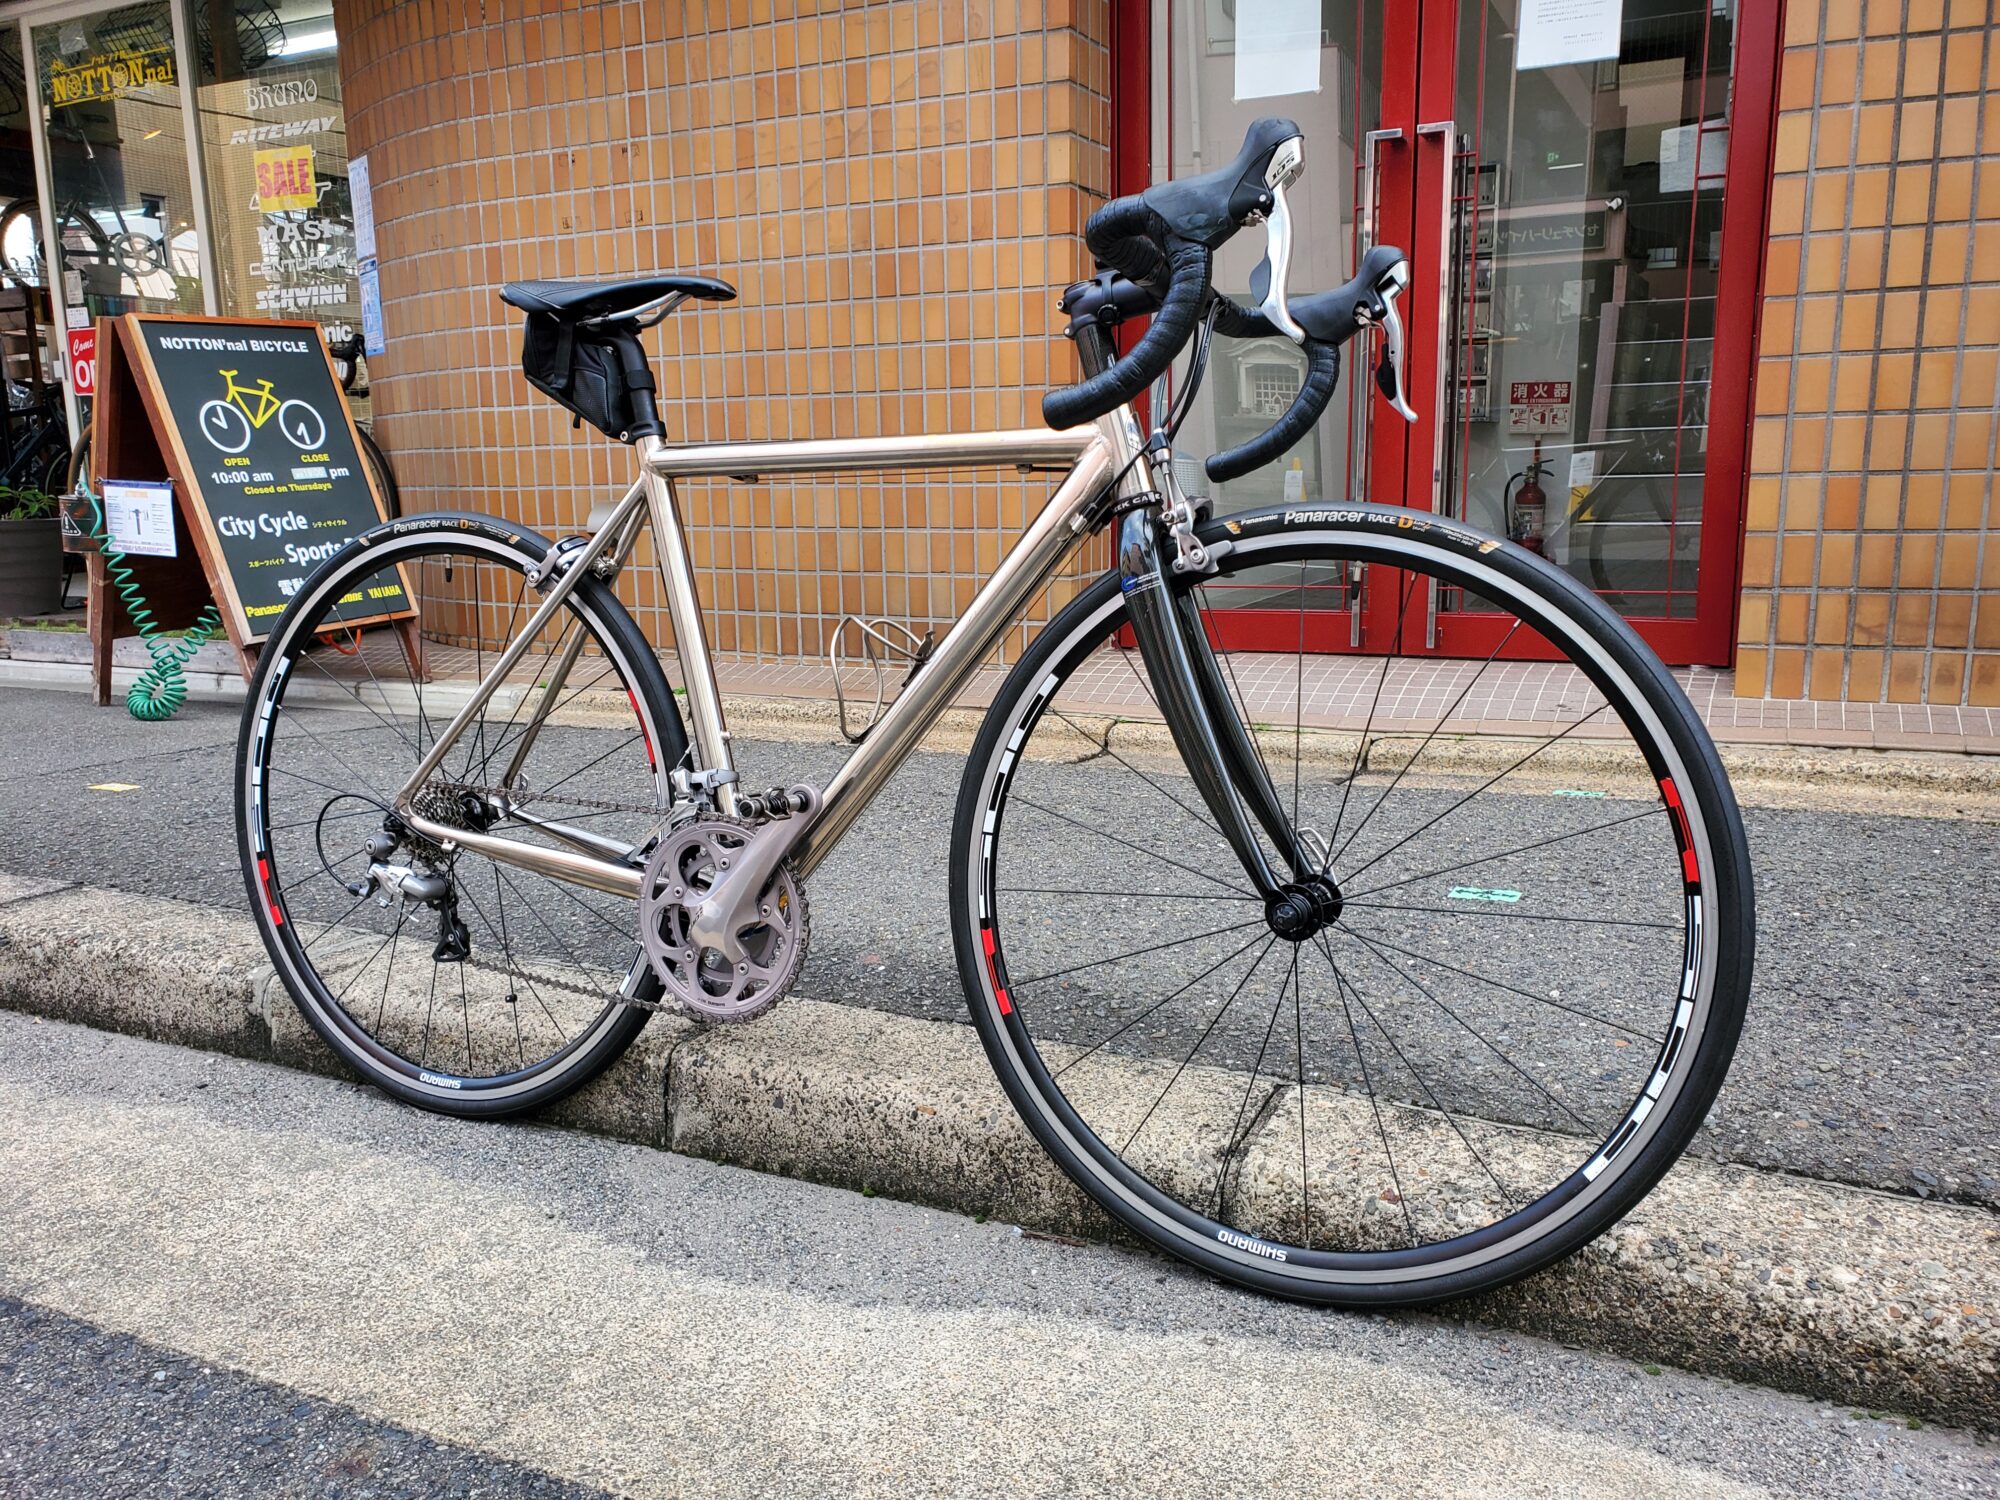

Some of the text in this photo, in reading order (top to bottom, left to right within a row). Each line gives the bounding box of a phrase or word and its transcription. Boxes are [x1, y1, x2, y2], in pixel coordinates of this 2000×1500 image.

[244, 79, 317, 112] BRUNO
[230, 116, 337, 145] RITEWAY
[256, 158, 312, 199] SALE
[256, 283, 347, 310] SCHWINN
[73, 338, 94, 356] Come
[160, 336, 309, 353] NOTTON'nal BICYCLE
[1513, 383, 1569, 399] 消火器
[224, 457, 251, 467] OPEN
[301, 453, 331, 463] CLOSE
[211, 470, 275, 485] 10:00 am
[329, 467, 350, 480] pm
[244, 481, 333, 495] Closed on Thursdays
[218, 511, 309, 540] City Cycle
[1241, 513, 1279, 526] Panasonic
[1284, 510, 1365, 525] Panaracer
[1367, 513, 1397, 525] RACE
[393, 519, 441, 534] Panaracer
[441, 520, 459, 528] RACE
[420, 1072, 462, 1089] SHIMANO
[1217, 1229, 1288, 1262] SHIMANO
